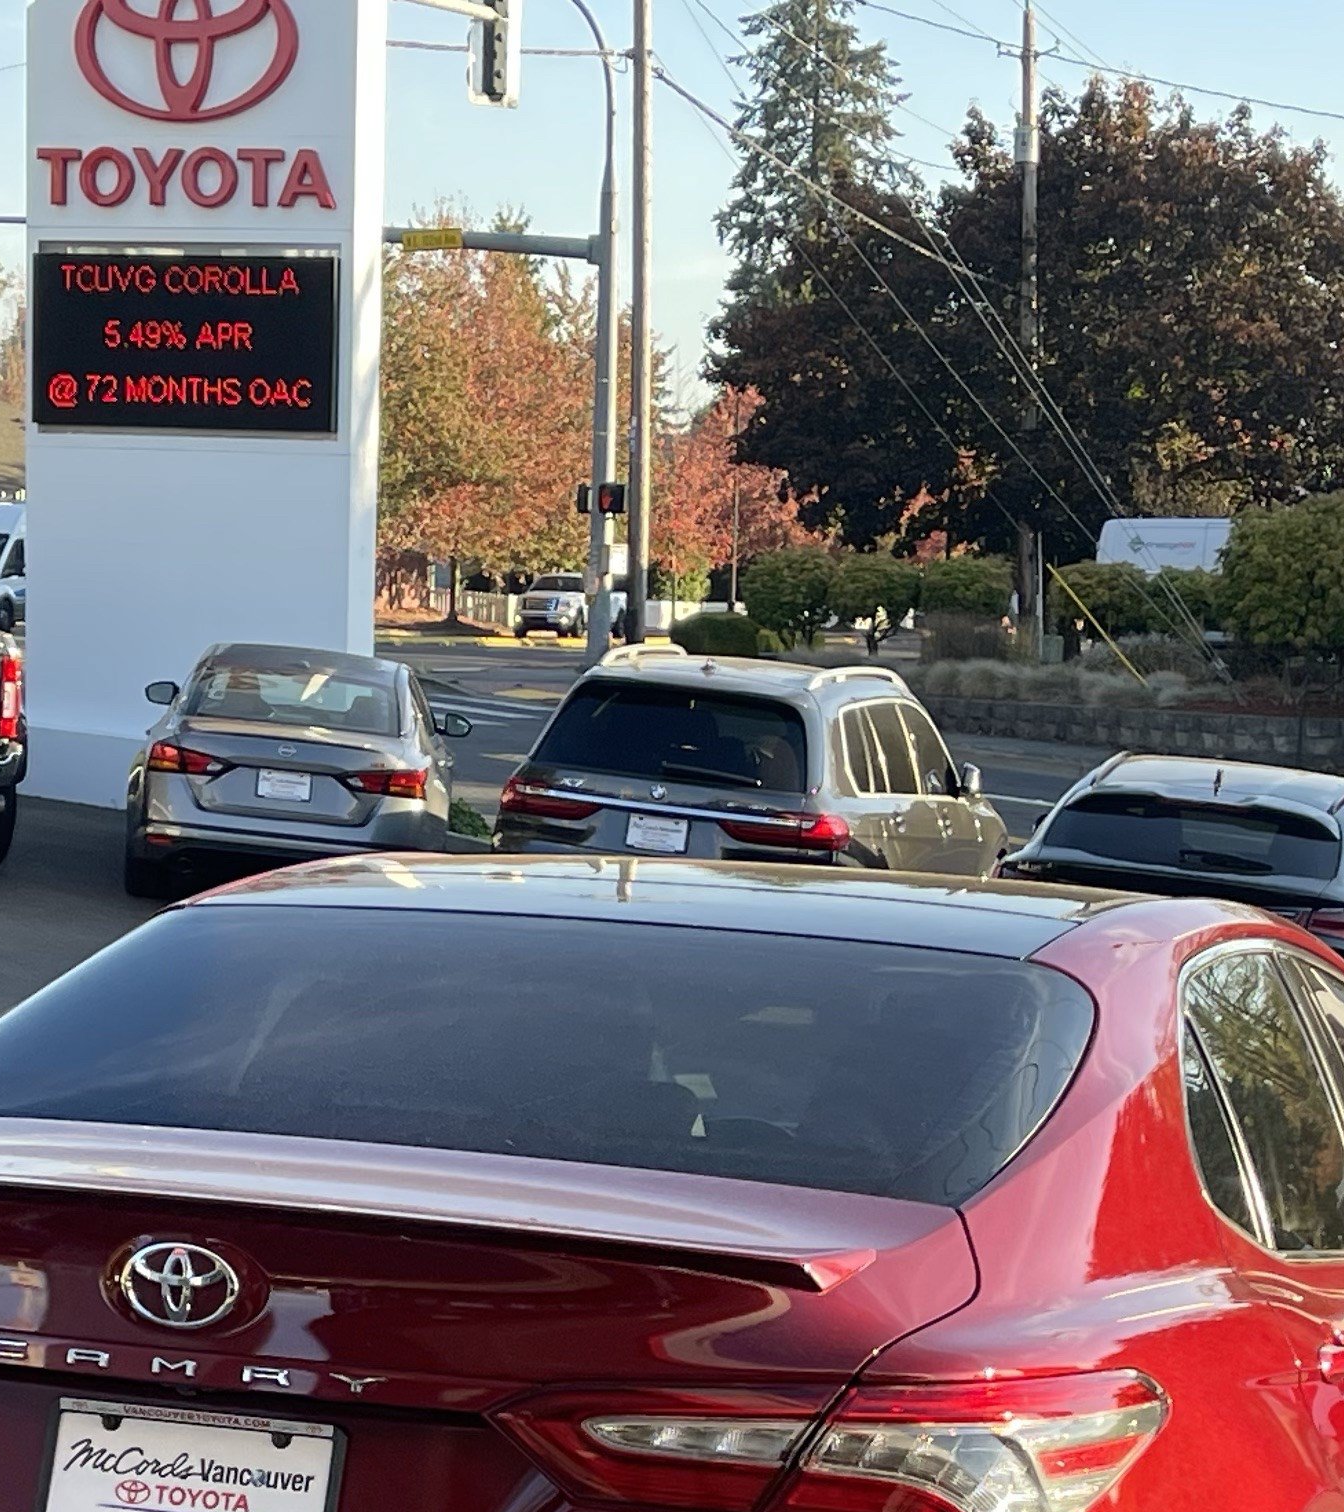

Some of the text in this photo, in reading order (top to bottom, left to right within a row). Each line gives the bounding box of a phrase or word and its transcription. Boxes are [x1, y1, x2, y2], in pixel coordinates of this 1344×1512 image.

[36, 146, 337, 210] TOYOTA
[60, 264, 300, 296] TCUVG COROLLA
[104, 319, 253, 351] 5.49% APR
[47, 372, 313, 408] @ 72 MONTHS OAC
